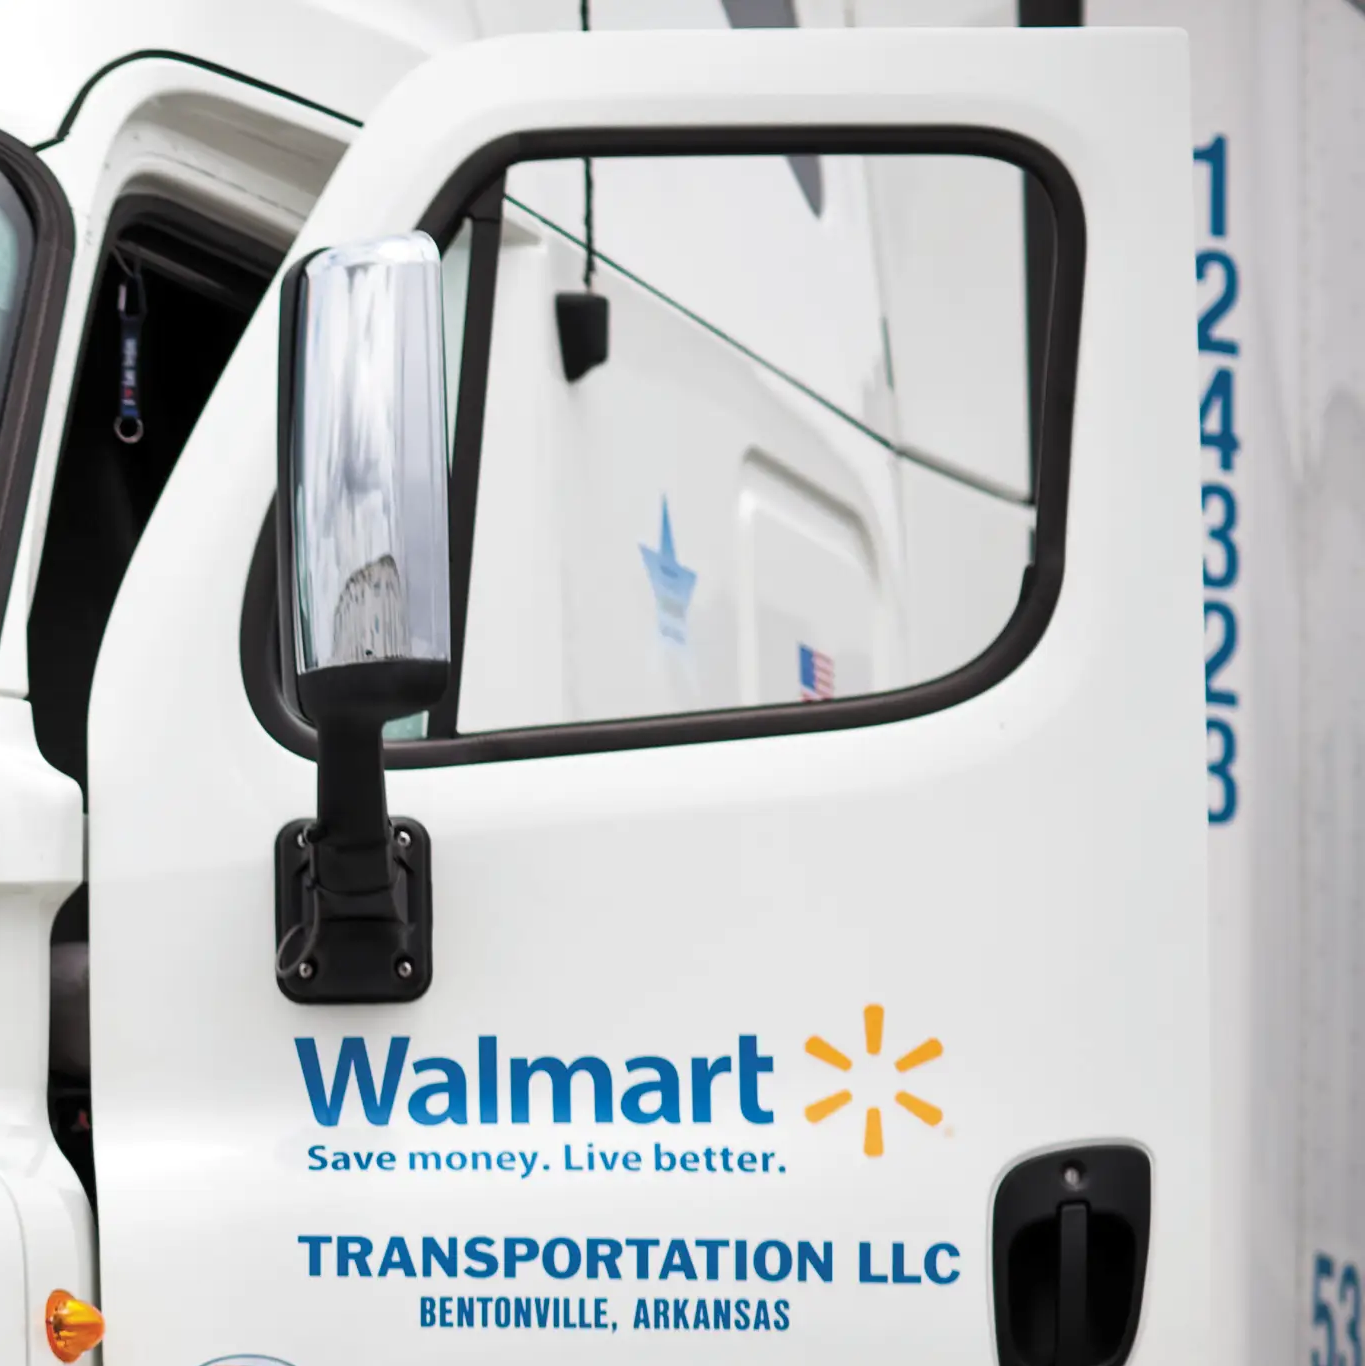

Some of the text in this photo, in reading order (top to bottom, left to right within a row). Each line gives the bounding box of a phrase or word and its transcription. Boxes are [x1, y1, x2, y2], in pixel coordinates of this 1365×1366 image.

[294, 1034, 774, 1127] Walmart
[307, 1143, 787, 1179] Save money. Live better.
[297, 1235, 962, 1285] TRANSPORTATION LLC
[419, 1296, 790, 1334] BENTONVILLE, ARKANSAS
